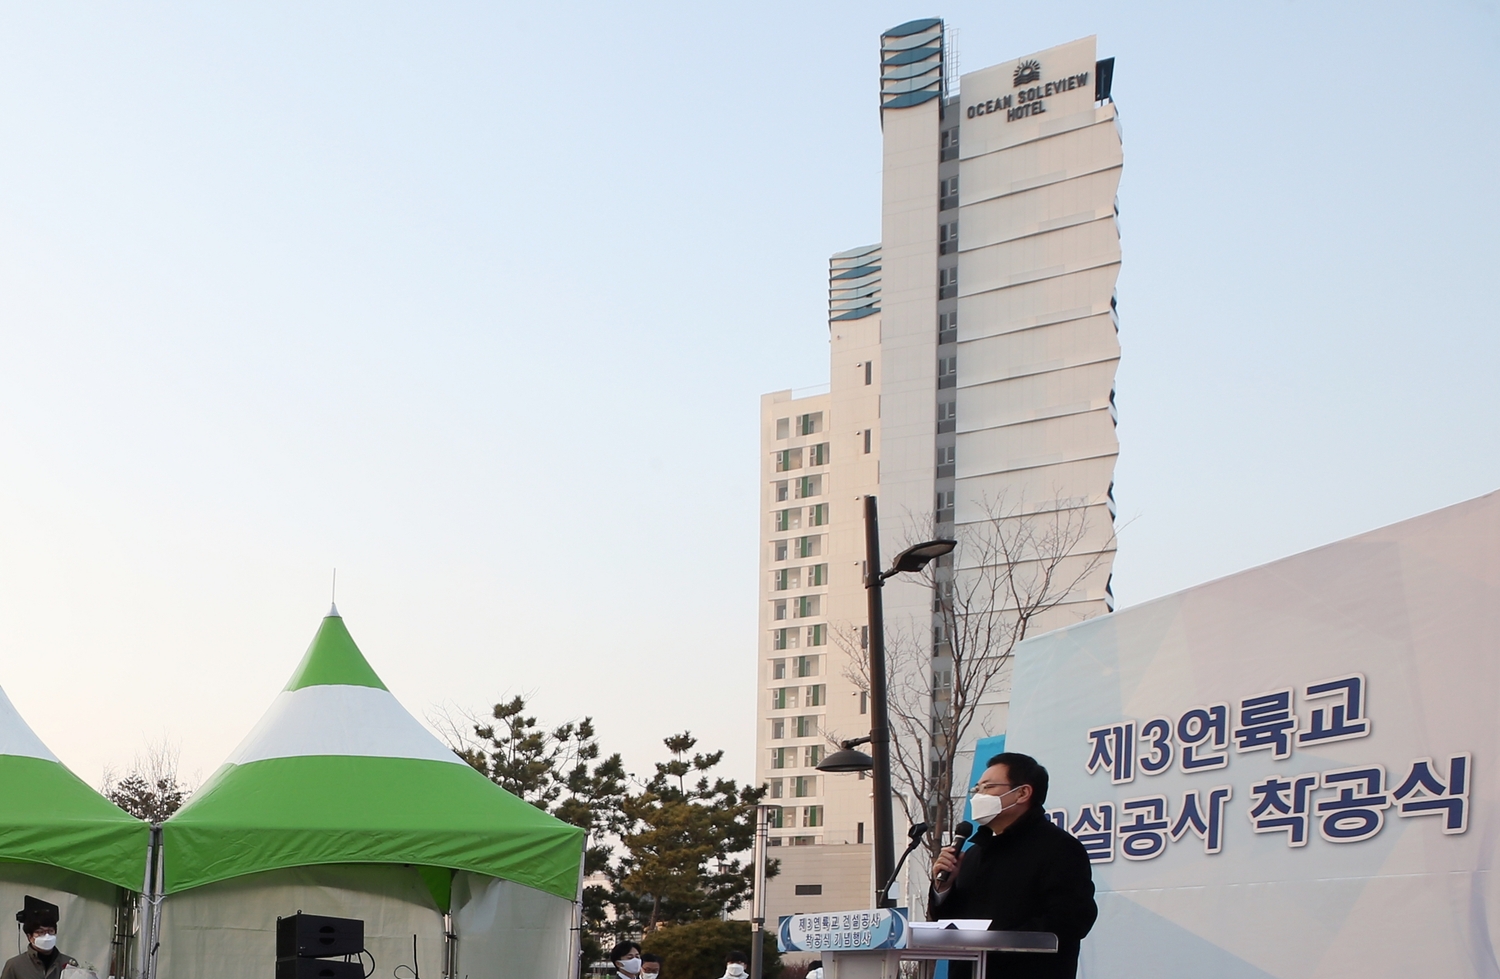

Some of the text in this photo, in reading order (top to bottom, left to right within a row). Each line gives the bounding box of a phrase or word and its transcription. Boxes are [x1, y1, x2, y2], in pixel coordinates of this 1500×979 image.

[967, 72, 1089, 119] OCEAN SOLEVIEW
[1007, 100, 1046, 123] HOTEL
[1088, 676, 1367, 782] 제3연륙교
[1045, 756, 1467, 860] 설공사 착공식
[799, 913, 880, 931] 제3연륙교 건설공사
[806, 931, 871, 948] 착공식 기념행사
